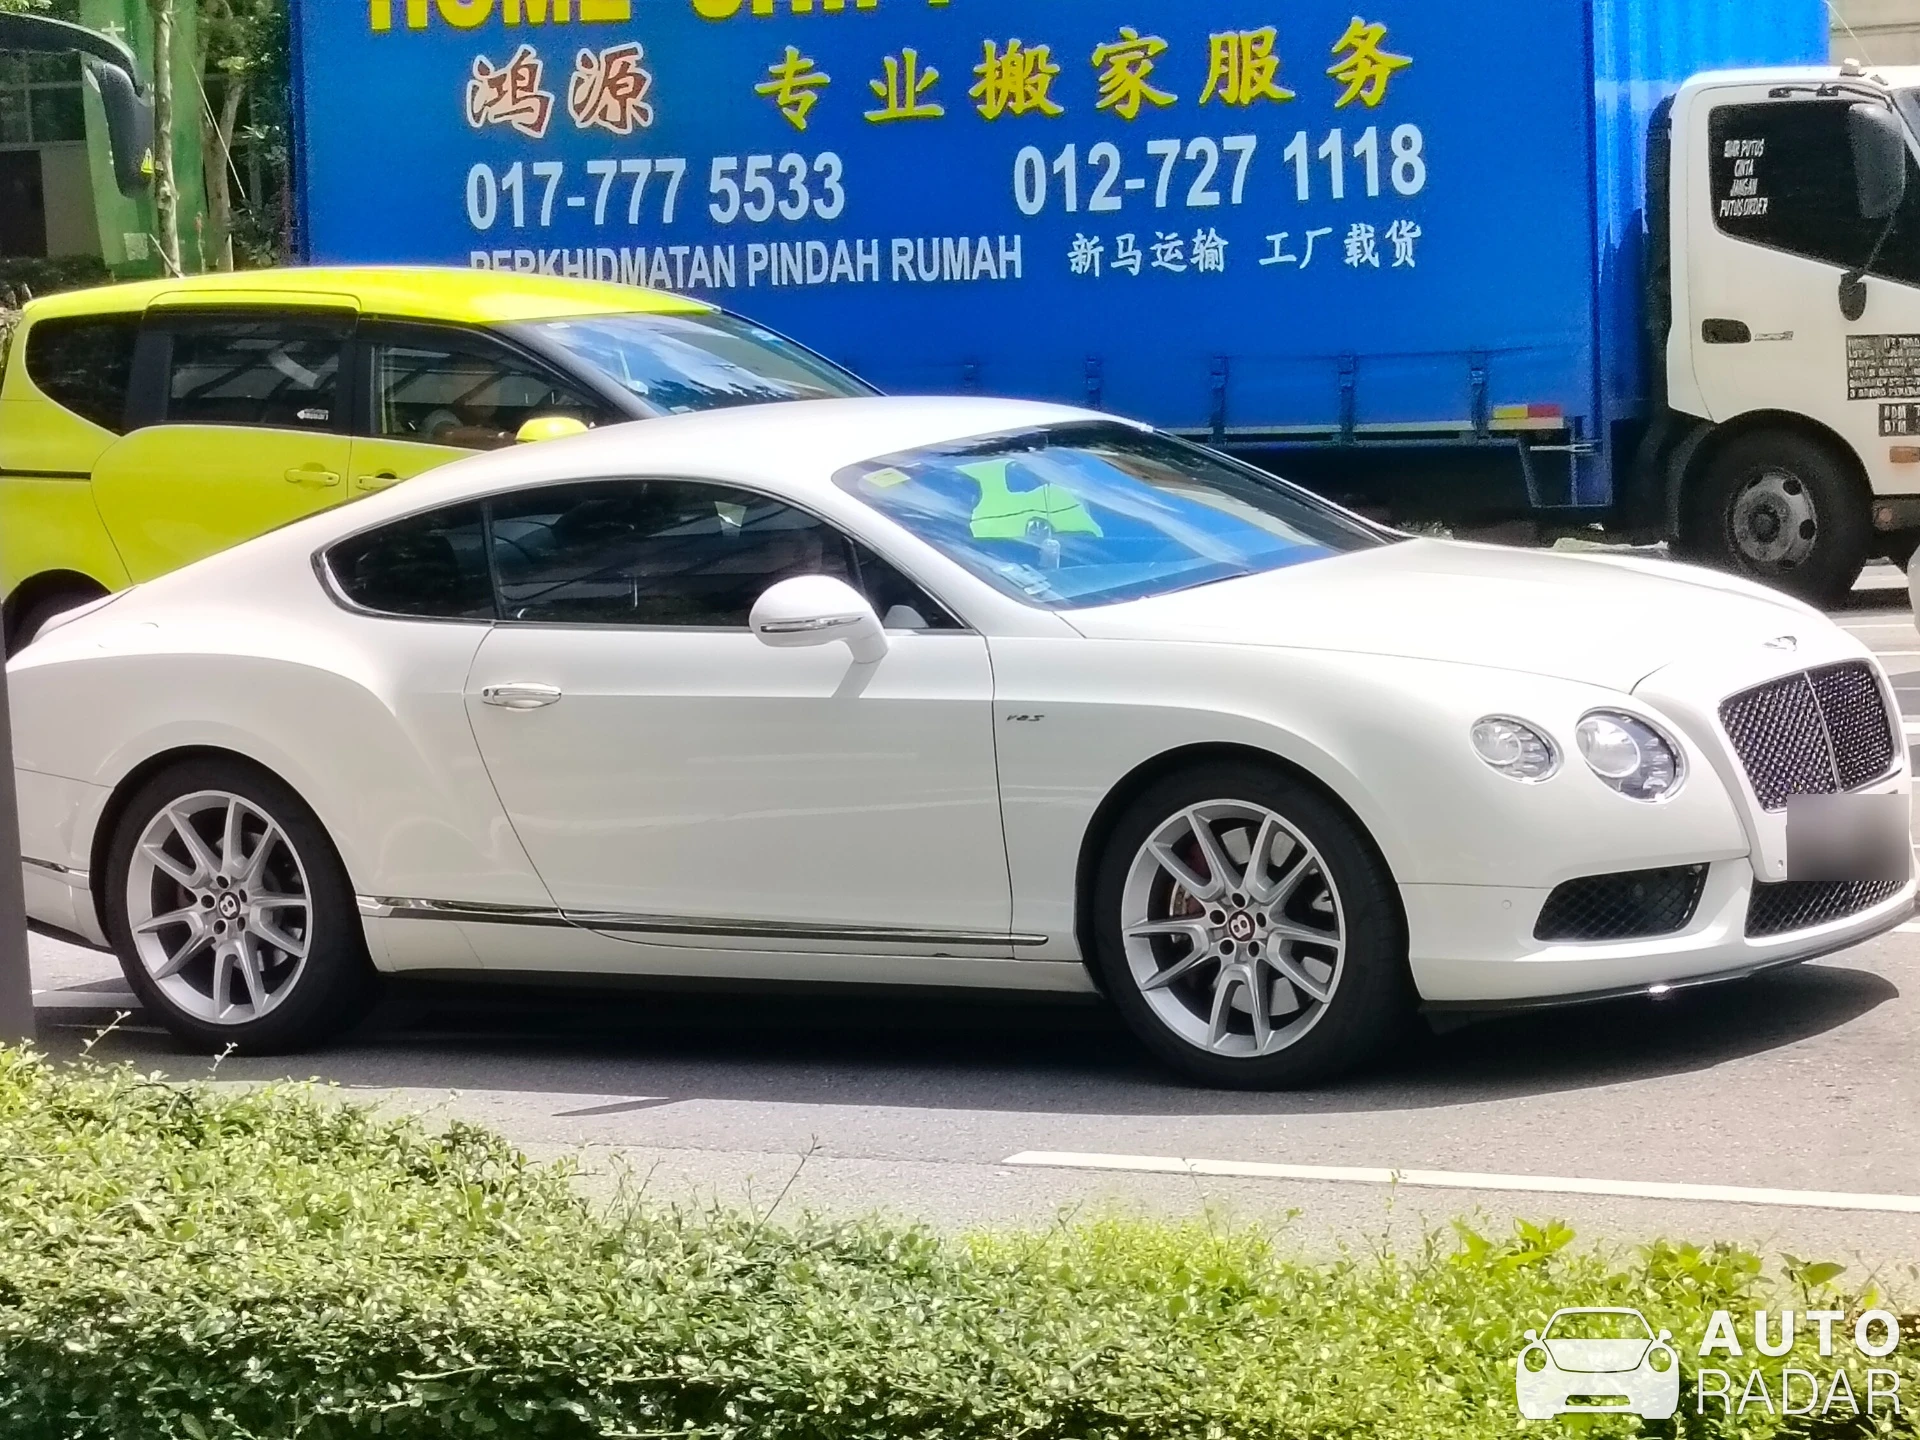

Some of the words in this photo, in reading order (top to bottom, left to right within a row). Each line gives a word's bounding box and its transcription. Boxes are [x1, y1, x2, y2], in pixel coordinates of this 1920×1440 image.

[467, 42, 654, 139] 鸿源
[754, 15, 1413, 131] 专业搬家服务
[467, 158, 687, 230] 017-777
[709, 152, 846, 224] 5533
[1014, 135, 1258, 215] 012-727
[1283, 124, 1427, 202] 1118
[748, 240, 880, 288] PINDAH
[892, 235, 1023, 283] RUMAH
[1067, 228, 1230, 277] 新马运输
[1259, 220, 1423, 269] 工厂载货
